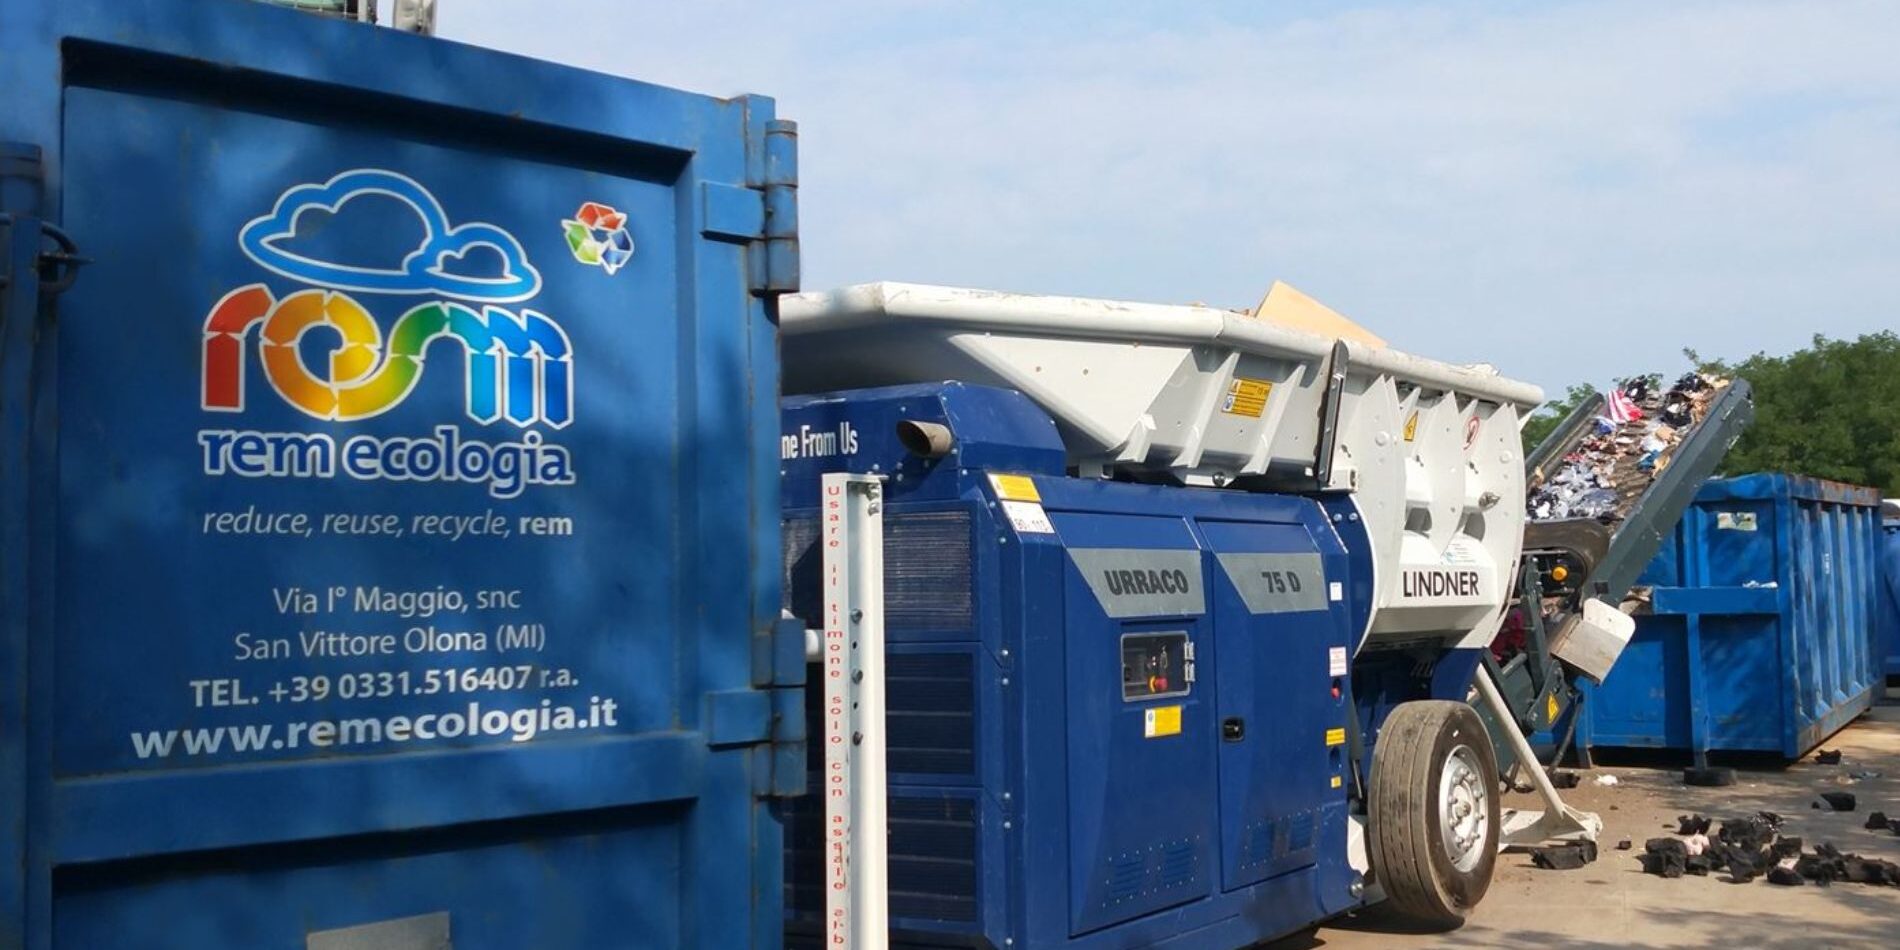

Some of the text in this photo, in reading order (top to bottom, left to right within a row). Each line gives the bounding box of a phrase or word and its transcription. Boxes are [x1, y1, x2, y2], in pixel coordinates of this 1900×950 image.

[801, 425, 836, 458] From
[840, 421, 858, 455] Us
[199, 425, 575, 499] rem ecologia
[203, 506, 573, 541] reduce, reuse, recycle, rem
[828, 485, 840, 548] Usare
[1104, 569, 1301, 596] URRACO 75 D
[1403, 571, 1479, 597] LINDNER
[273, 588, 318, 614] Via
[354, 585, 468, 618] Maggio,
[477, 589, 521, 610] snc
[235, 624, 545, 660] San Vittore Olona (MI)
[827, 604, 843, 678] timone
[190, 665, 579, 707] TEL. +39 0331.516407 r.a.
[130, 695, 618, 759] www.remecologia.it
[831, 696, 842, 743] solo
[832, 762, 842, 796] con
